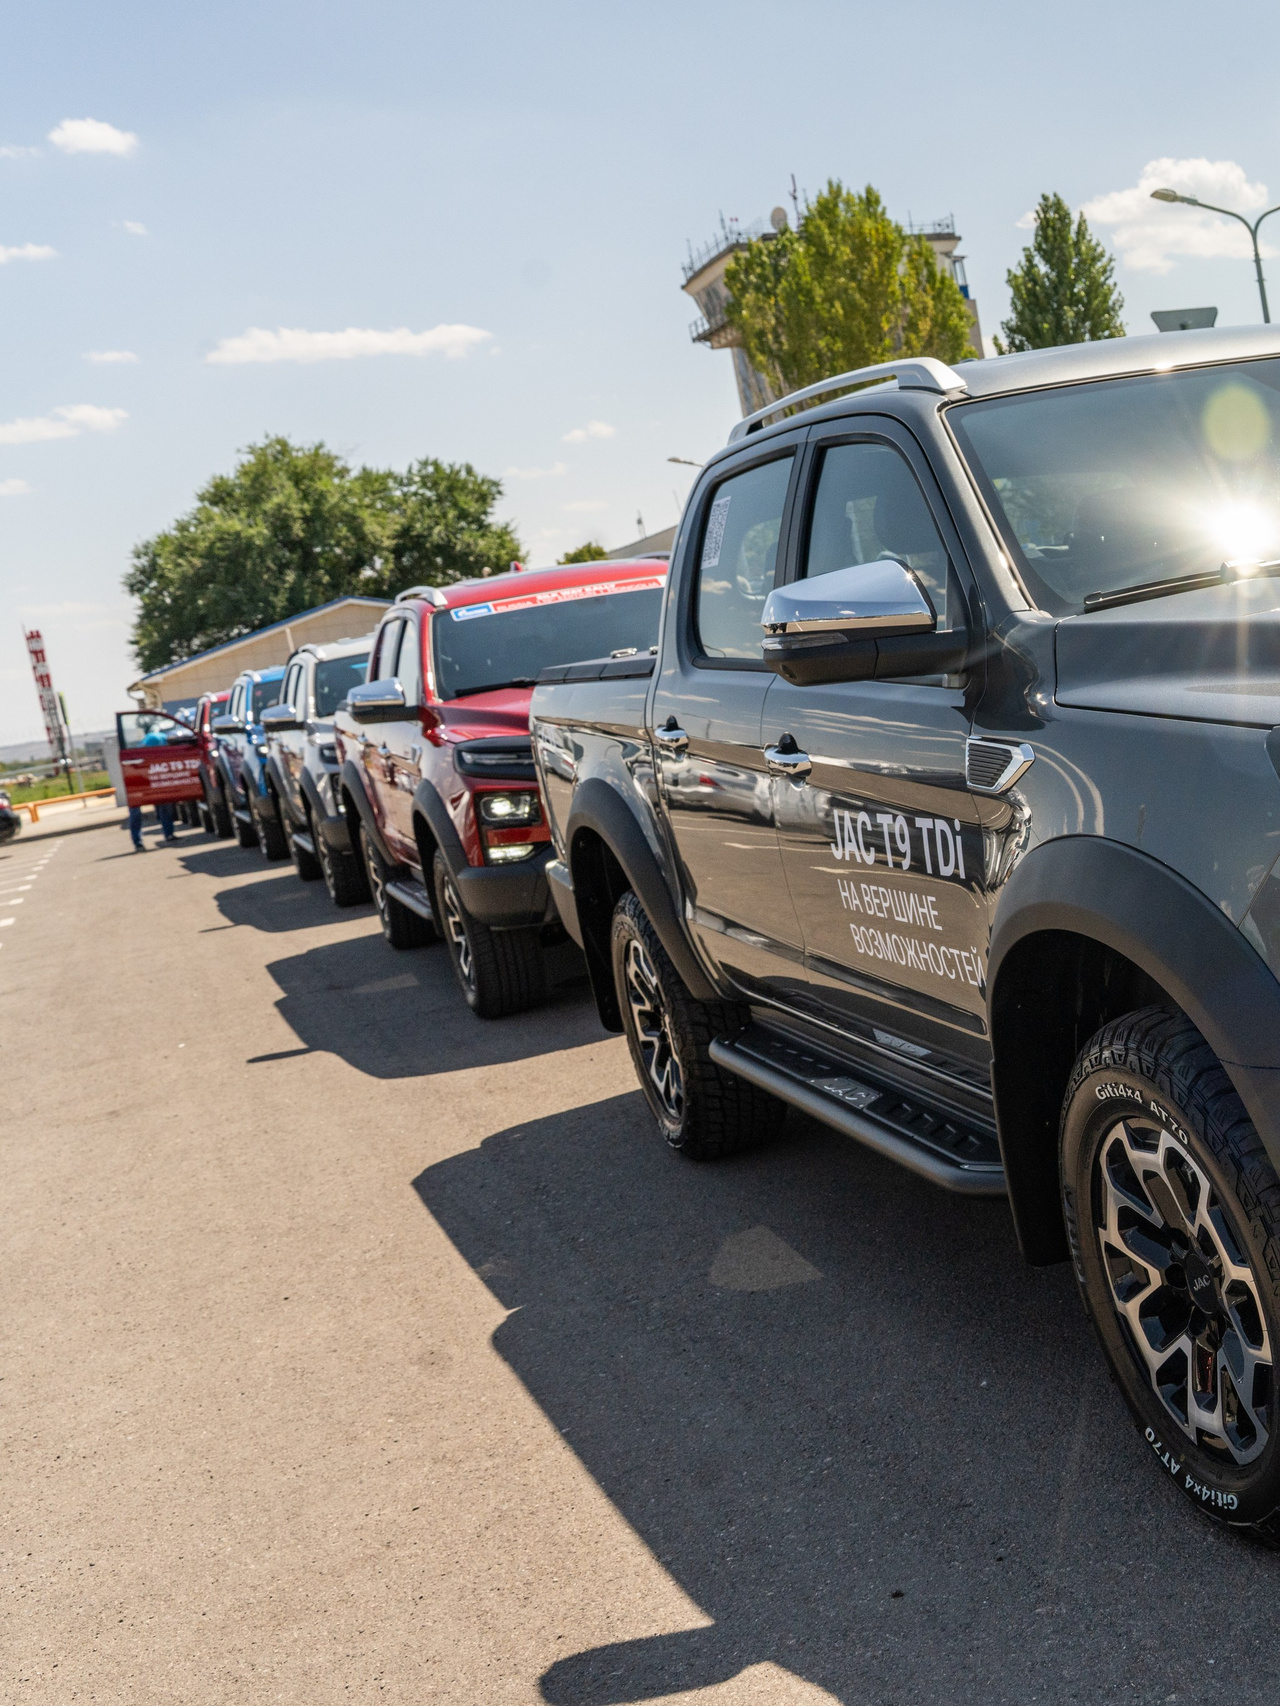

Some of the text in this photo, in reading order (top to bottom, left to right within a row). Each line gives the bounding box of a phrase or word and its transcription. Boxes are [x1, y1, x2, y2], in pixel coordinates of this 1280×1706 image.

[831, 810, 966, 879] JAC T9 TDi
[837, 879, 943, 931] НА ВЕРШИНЕ
[850, 923, 986, 988] ВОЗМОЖНОСТЕЙ
[1095, 1083, 1143, 1104] Giti4x4
[1193, 1274, 1211, 1291] JAC
[1184, 1474, 1239, 1510] Giti4x4
